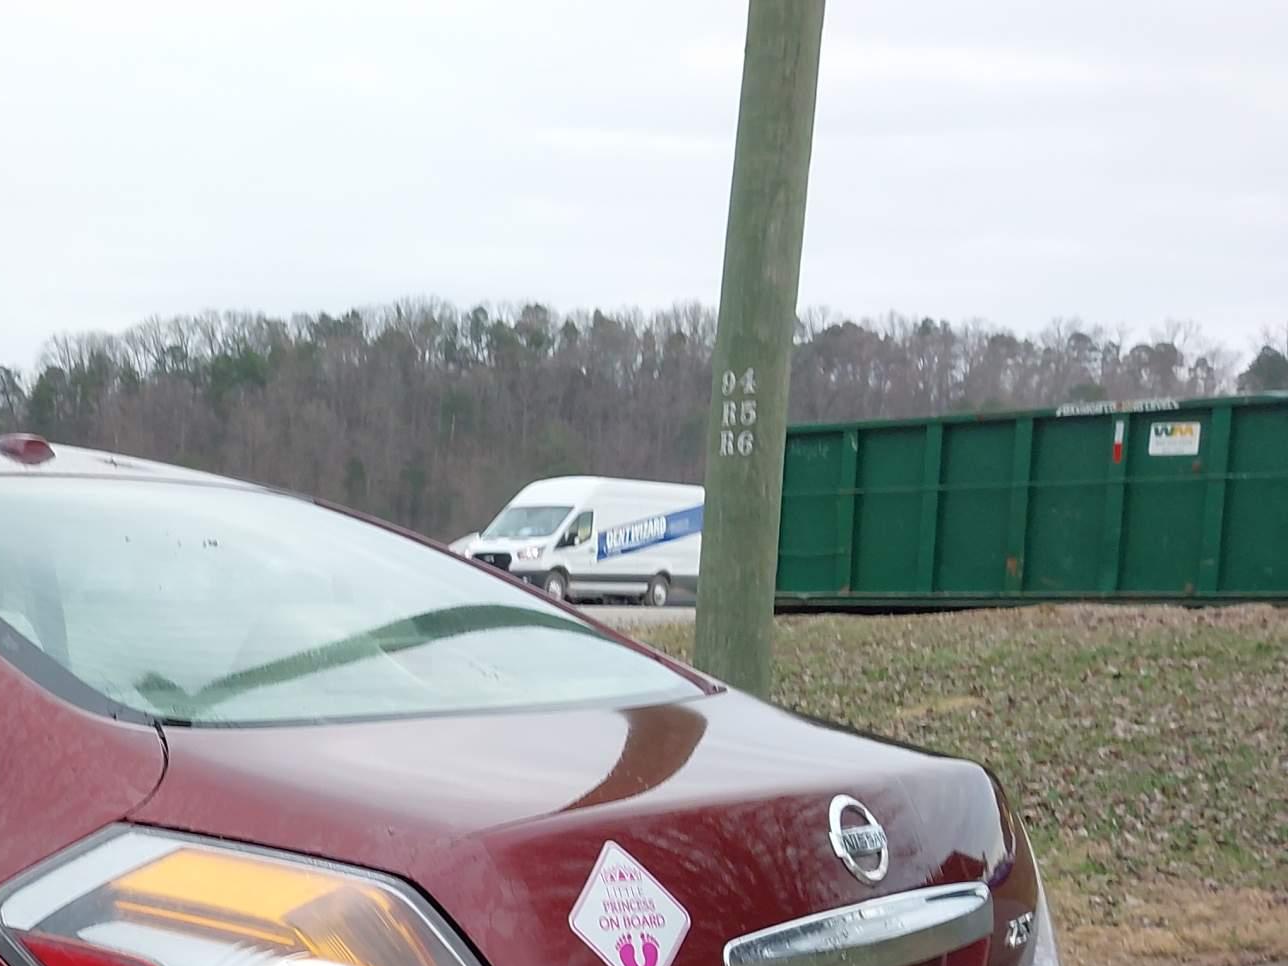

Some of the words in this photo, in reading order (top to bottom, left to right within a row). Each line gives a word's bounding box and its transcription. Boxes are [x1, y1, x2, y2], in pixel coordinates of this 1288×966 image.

[721, 400, 757, 427] R5
[720, 430, 754, 457] R6
[603, 899, 656, 914] PRINCESS
[599, 916, 620, 931] ON
[624, 914, 666, 930] BOARD
